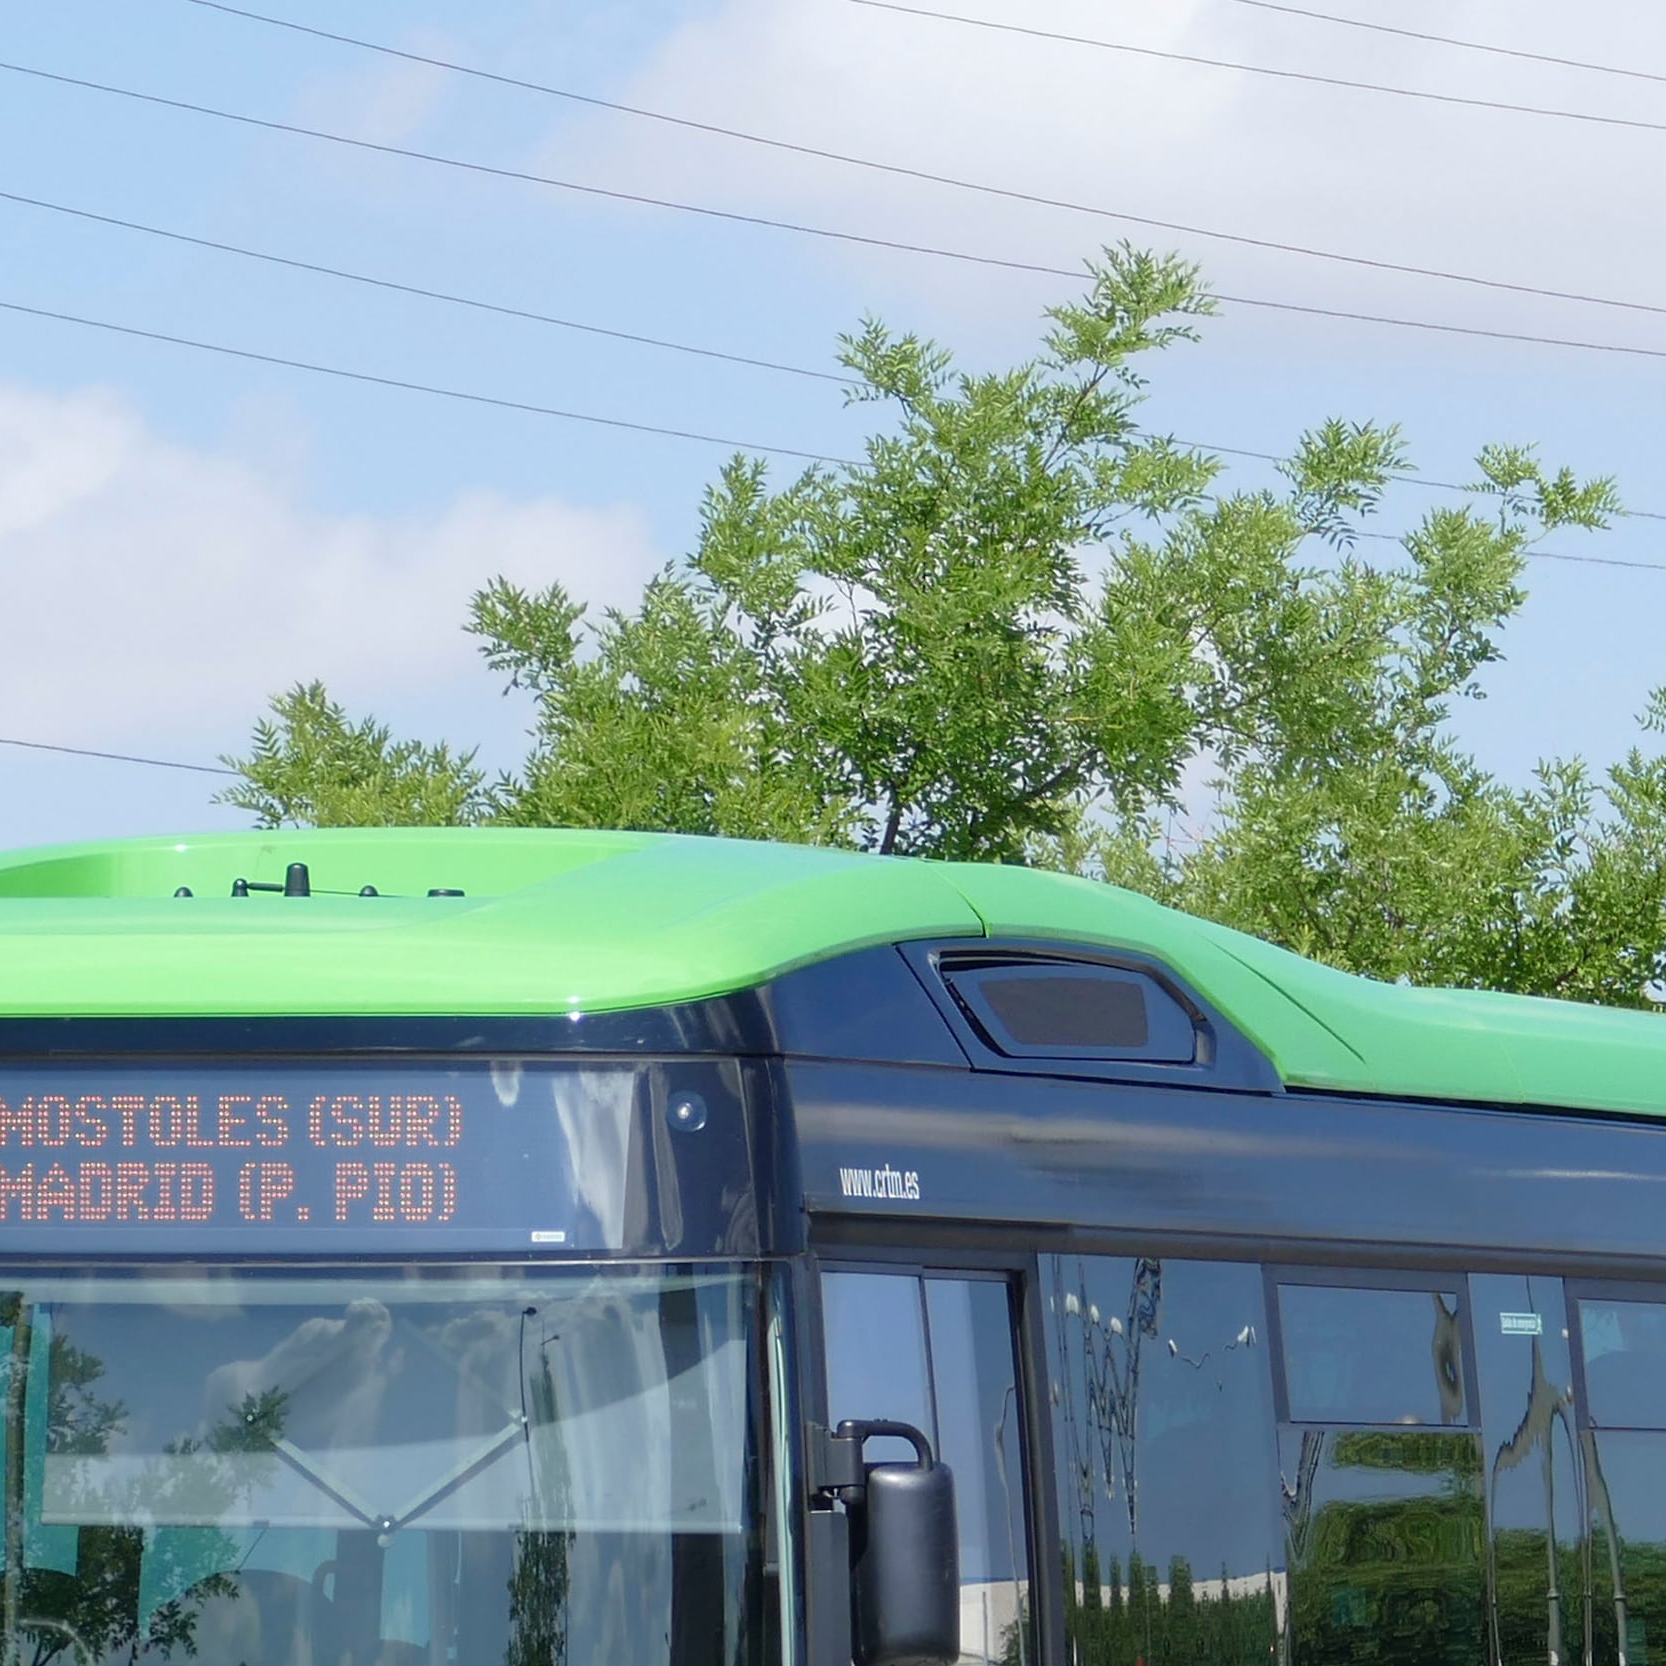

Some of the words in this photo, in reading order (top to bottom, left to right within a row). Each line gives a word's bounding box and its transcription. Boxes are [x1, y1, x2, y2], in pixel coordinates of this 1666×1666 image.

[309, 1095, 462, 1147] (SUR)
[335, 1162, 457, 1221] PIO)
[839, 1163, 920, 1200] www.crtm.es
